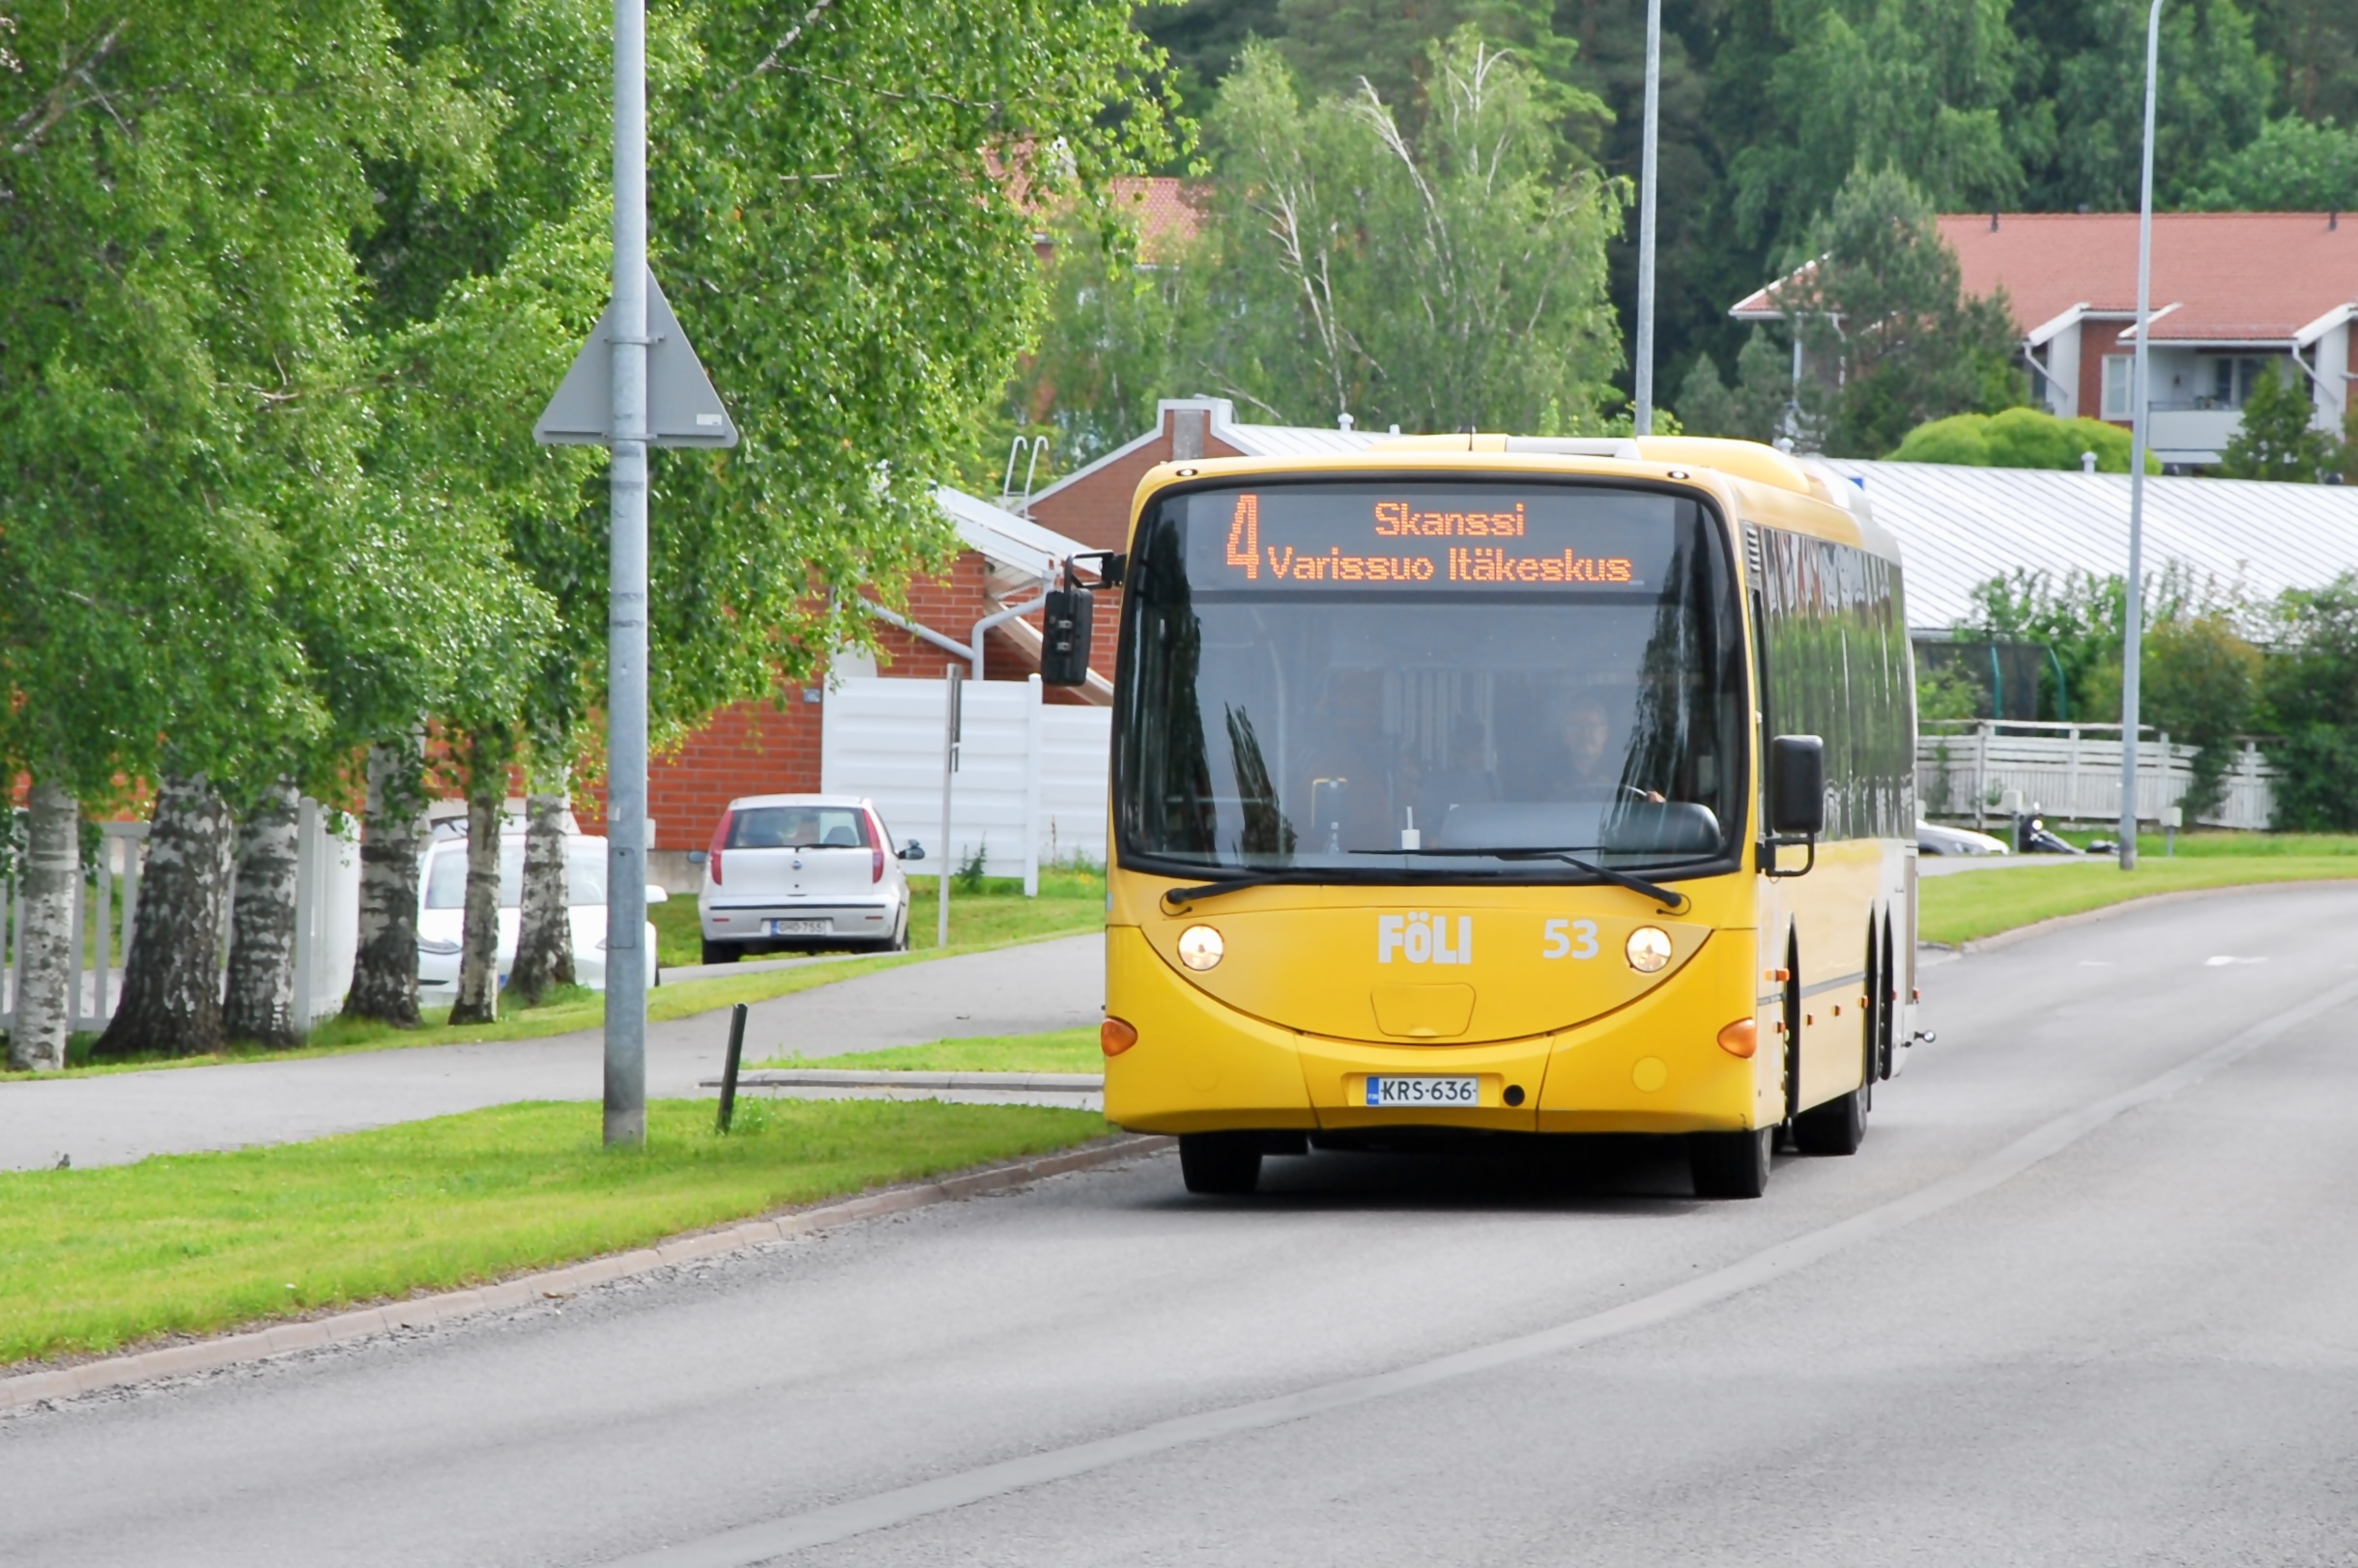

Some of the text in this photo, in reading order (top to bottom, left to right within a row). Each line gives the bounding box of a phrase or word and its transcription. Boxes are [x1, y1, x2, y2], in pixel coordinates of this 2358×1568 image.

[1227, 494, 1258, 579] 4
[1375, 502, 1524, 536] Skanssi
[1268, 546, 1631, 582] Varissuo Itäkeskus
[1378, 911, 1472, 964] FÖLI
[1542, 918, 1599, 959] 53
[1382, 1080, 1472, 1100] KRS-636
